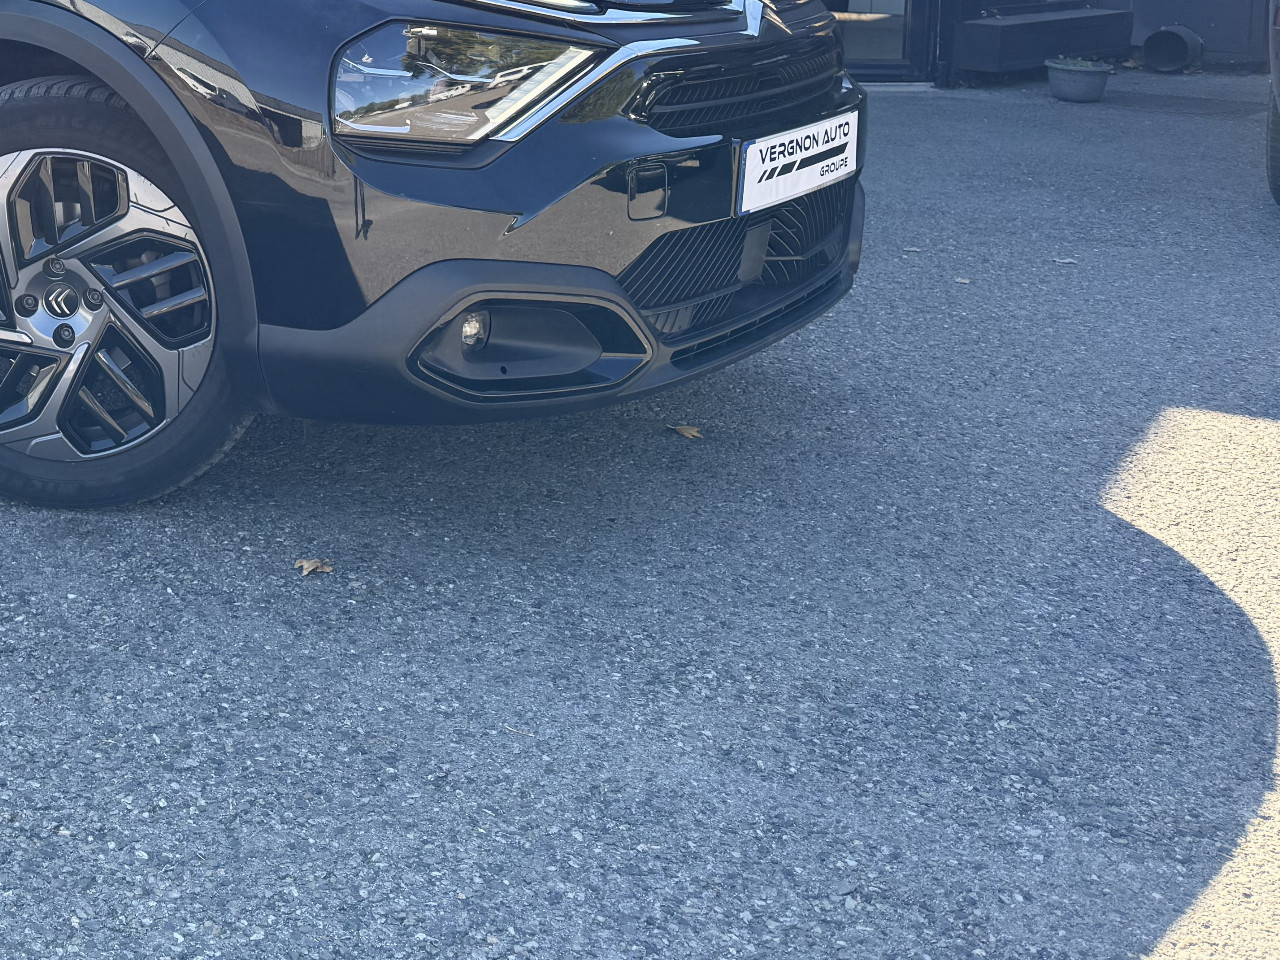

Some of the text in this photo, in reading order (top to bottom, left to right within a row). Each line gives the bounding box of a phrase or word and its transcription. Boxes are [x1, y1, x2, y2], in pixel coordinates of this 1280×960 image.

[759, 121, 850, 164] VERGNON AUTO
[820, 157, 848, 177] GROUPE
